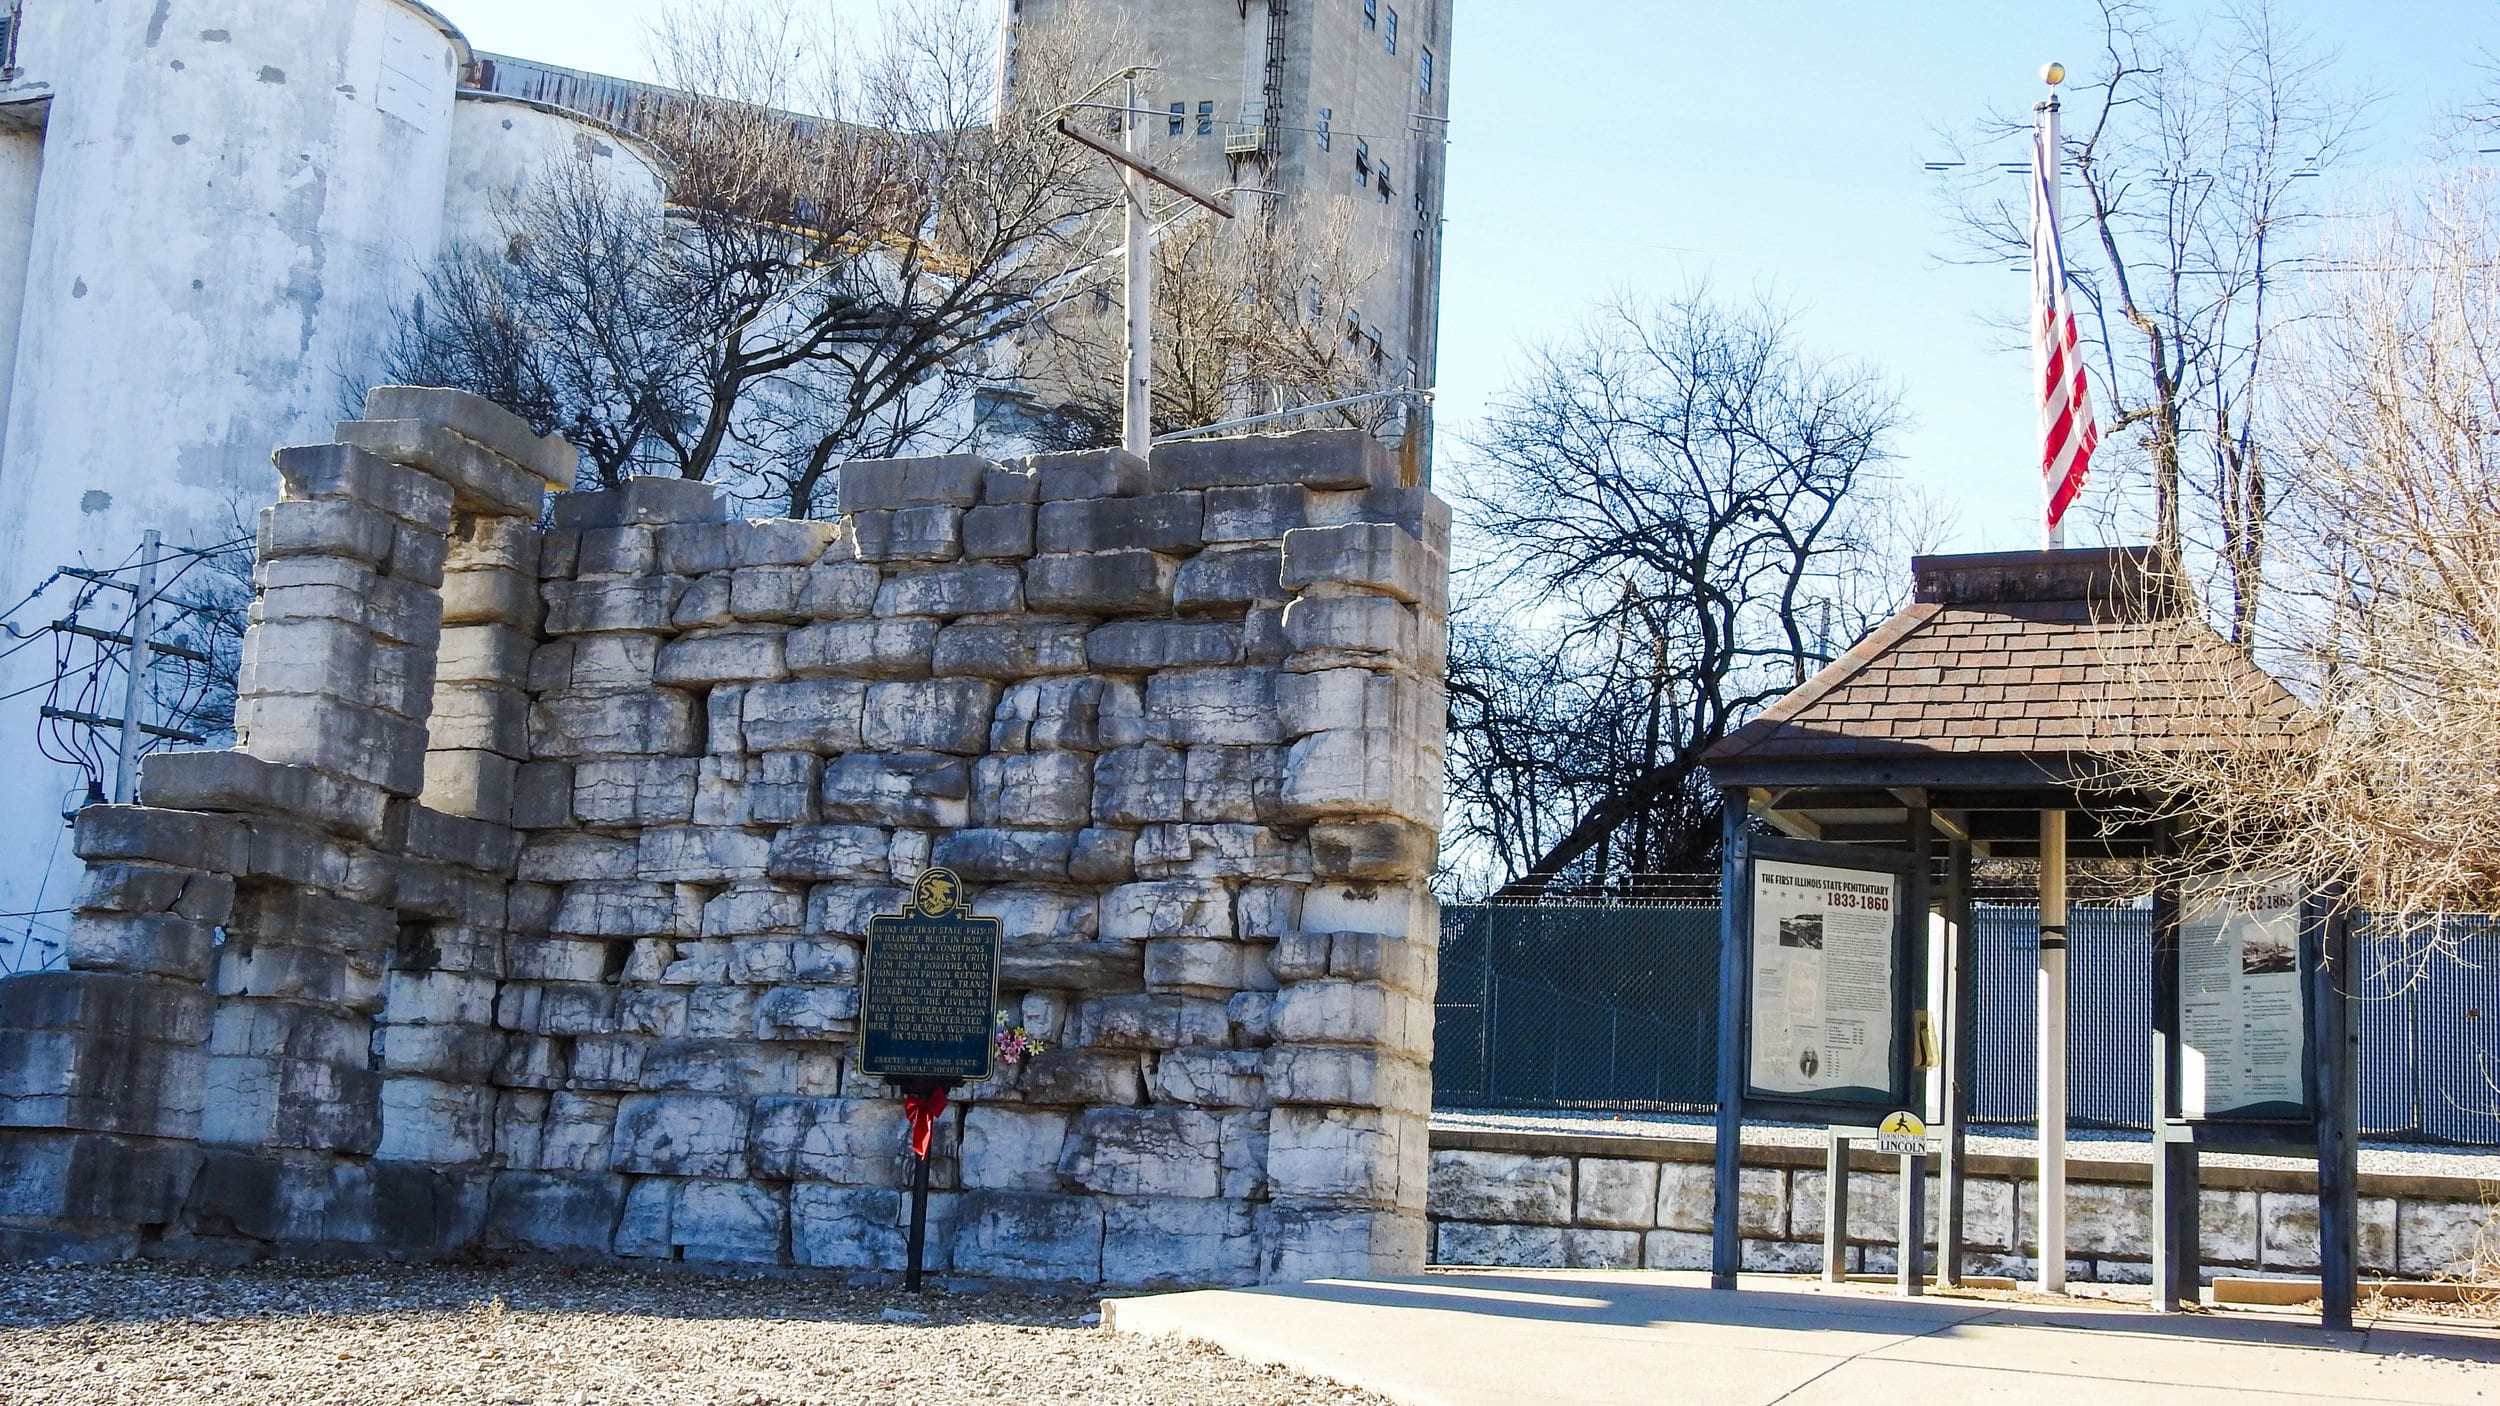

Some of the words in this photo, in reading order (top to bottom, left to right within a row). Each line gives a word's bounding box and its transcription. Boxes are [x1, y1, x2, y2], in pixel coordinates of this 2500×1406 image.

[1762, 873, 1774, 884] THE
[1775, 874, 1794, 886] FIRST
[1794, 877, 1822, 889] ILLINOIS
[1822, 879, 1842, 892] STATE
[1843, 882, 1889, 896] PENITENTIARY
[1827, 892, 1889, 912] 1833-1860
[874, 925, 897, 933] RUINS
[900, 925, 911, 933] OF
[913, 926, 936, 934] FIRST
[940, 926, 961, 935] STATE
[966, 926, 995, 935] PRISON
[873, 934, 881, 942] IN
[884, 934, 918, 943] ILLINOIS
[925, 935, 947, 944] BUILT
[950, 936, 960, 944] IN
[882, 943, 930, 952] UNSANITARY
[936, 944, 985, 953] CONDITIONS
[873, 952, 909, 961] AROUSED
[914, 953, 961, 961] PERSISTENT
[897, 961, 920, 970] FROM
[924, 962, 968, 970] DOROTHEA
[871, 969, 905, 978] PIONEER
[910, 970, 918, 978] IN
[920, 970, 950, 979] PRISON
[873, 978, 887, 986] ALL
[892, 979, 926, 987] INMATES
[930, 980, 953, 988] WERE
[871, 987, 902, 995] FERRED
[907, 987, 916, 995] TO
[919, 988, 946, 997] JOLIET
[949, 989, 973, 997] PRIOR
[977, 989, 989, 997] TO
[891, 996, 919, 1005] DURING
[925, 997, 940, 1006] THE
[944, 998, 966, 1006] CIVIL
[969, 999, 987, 1007] WAR
[868, 1004, 893, 1012] MANY
[895, 1005, 953, 1015] CONFEDERATE
[875, 1013, 890, 1021] ERS
[894, 1014, 915, 1022] WERE
[921, 1015, 982, 1025] INCARCERATED
[868, 1022, 889, 1030] HERE
[894, 1023, 910, 1031] AND
[913, 1023, 943, 1032] DEATHS
[945, 1025, 987, 1034] AVERAGED
[891, 1032, 903, 1040] SIX
[907, 1032, 917, 1040] TO
[921, 1033, 937, 1041] TEN
[956, 1059, 976, 1067] STATE
[1880, 1140, 1926, 1153] LINCOLN
